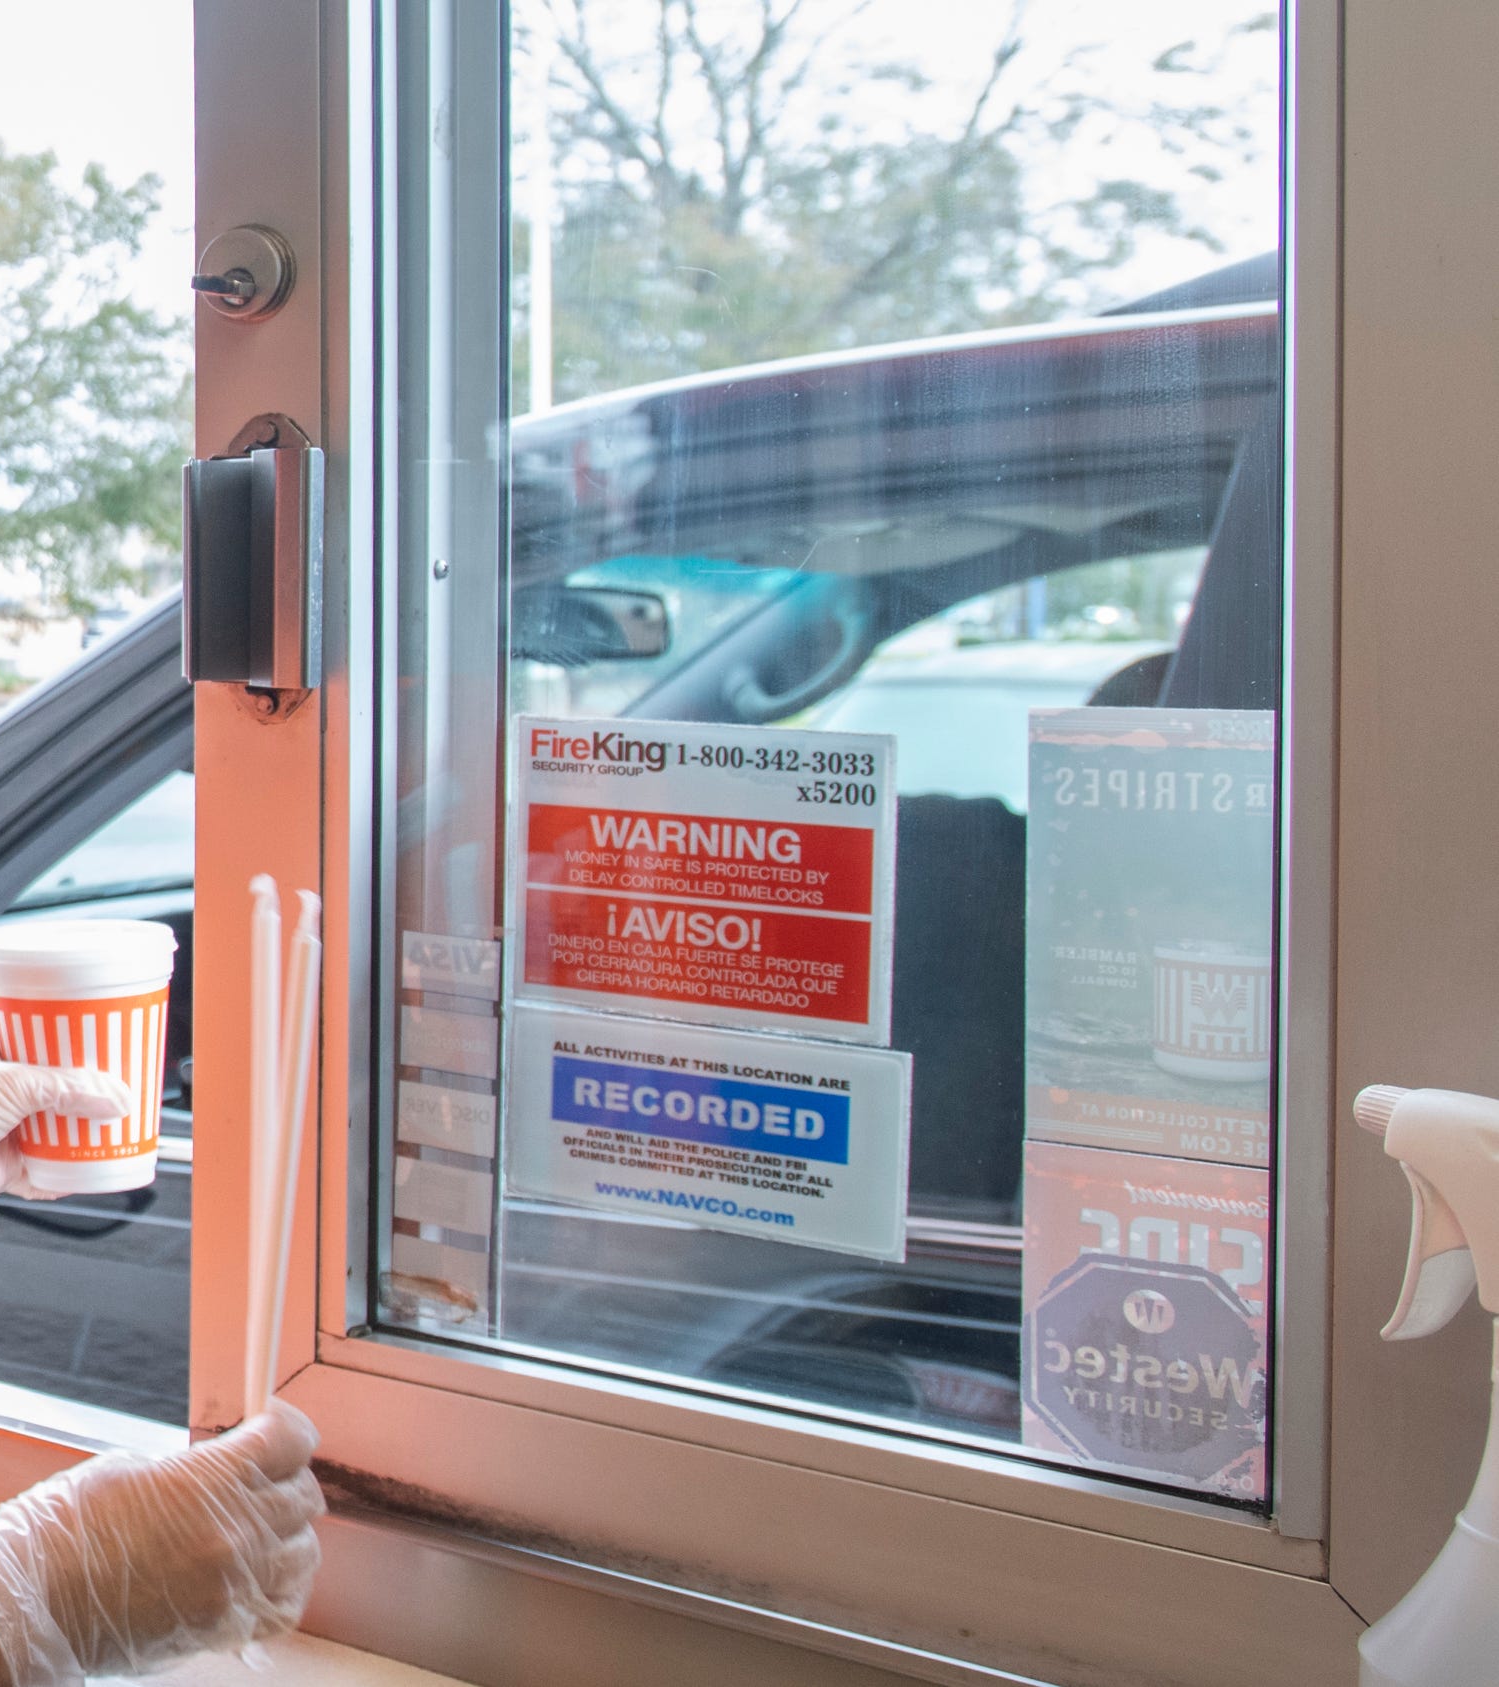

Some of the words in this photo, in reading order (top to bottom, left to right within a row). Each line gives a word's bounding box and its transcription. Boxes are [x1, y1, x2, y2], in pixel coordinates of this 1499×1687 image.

[530, 728, 667, 773] FireKing
[677, 744, 876, 777] 1-800-342-3033
[532, 760, 595, 775] SECURITY
[597, 764, 644, 778] GROUP
[797, 783, 877, 807] x5200
[588, 814, 802, 864] WARNING
[564, 849, 621, 867] MONEY
[623, 855, 640, 869] IN
[643, 856, 683, 874] SAFE
[685, 861, 702, 875] IS
[705, 863, 802, 885] PROTECTED
[805, 871, 831, 886] BY
[569, 869, 618, 887] DELAY
[619, 873, 726, 898] CONTROLLED
[728, 883, 825, 906] TIMELOCKS
[607, 904, 763, 952] ¡AVISO!
[548, 934, 605, 952] DINERO
[608, 940, 630, 954] EN
[632, 941, 674, 959] CAJA
[676, 945, 738, 965] FUERTE
[740, 951, 762, 968] SE
[764, 955, 845, 980] PROTEGE
[552, 950, 586, 967] POR
[588, 953, 684, 979] CERRADURA
[686, 963, 799, 990] CONTROLADA
[801, 977, 838, 996] QUE
[576, 969, 632, 988] CIERRA
[635, 974, 708, 997] HORARIO
[710, 984, 811, 1010] RETARDADO
[553, 1040, 580, 1055] ALL
[584, 1044, 666, 1066] ACTIVITIES
[669, 1055, 689, 1069] AT
[693, 1057, 730, 1075] THIS
[733, 1063, 815, 1086] LOCATION
[818, 1074, 851, 1091] ARE
[572, 1076, 826, 1142] RECORDED
[563, 1136, 626, 1156] OFFICIALS
[629, 1144, 643, 1156] IN
[646, 1147, 686, 1164] THEIR
[688, 1153, 782, 1181] PROSECUTION
[785, 1168, 805, 1182] OF
[807, 1171, 834, 1189] ALL
[586, 1127, 612, 1142] AND
[614, 1131, 645, 1147] WILL
[648, 1136, 670, 1150] AID
[673, 1139, 699, 1154] THE
[702, 1143, 751, 1163] POLICE
[753, 1152, 782, 1167] AND
[785, 1157, 808, 1172] FBI
[569, 1148, 616, 1166] CRIMES
[618, 1154, 696, 1178] COMMITTED
[699, 1167, 716, 1180] AT
[718, 1170, 750, 1186] THIS
[752, 1176, 826, 1199] LOCATION.
[594, 1181, 796, 1228] www.NAVCO.com
